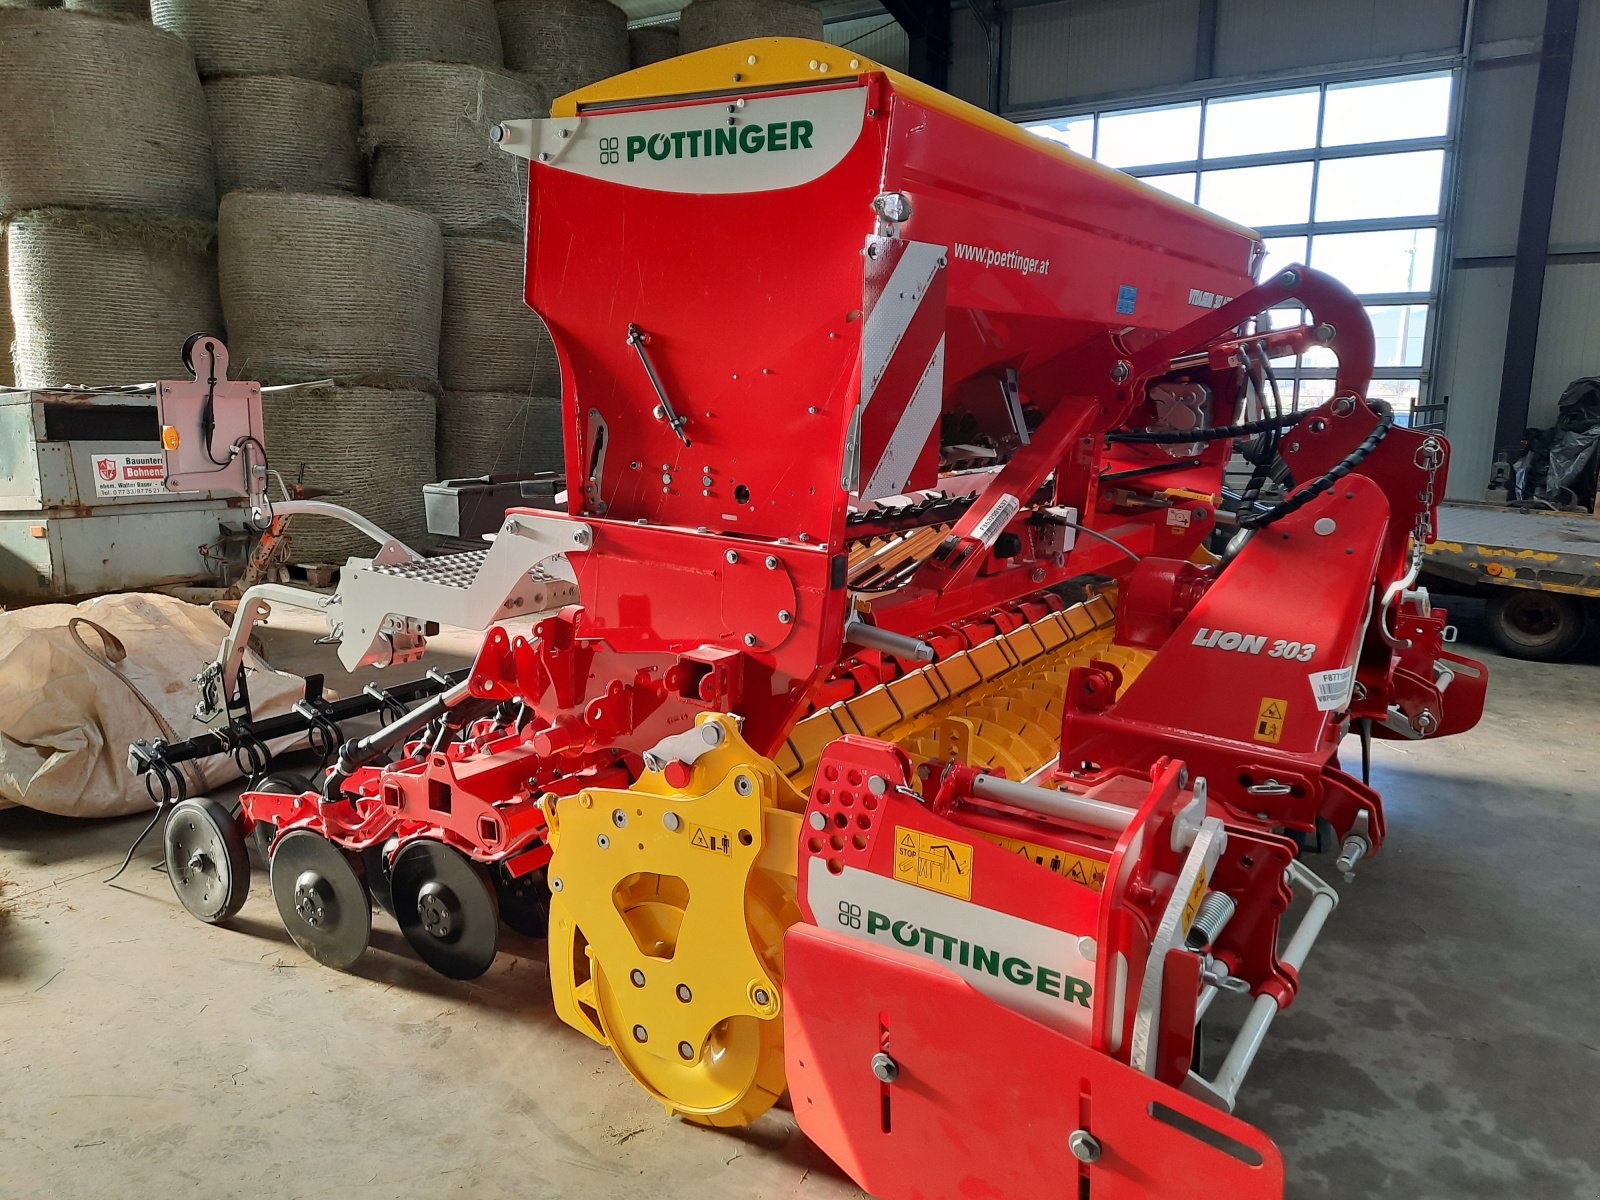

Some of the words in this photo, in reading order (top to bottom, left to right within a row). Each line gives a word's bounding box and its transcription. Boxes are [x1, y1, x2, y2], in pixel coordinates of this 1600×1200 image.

[954, 242, 1050, 275] www.poettinger.at
[1191, 627, 1269, 655] LION
[1268, 639, 1316, 662] 303
[899, 847, 917, 858] STOP
